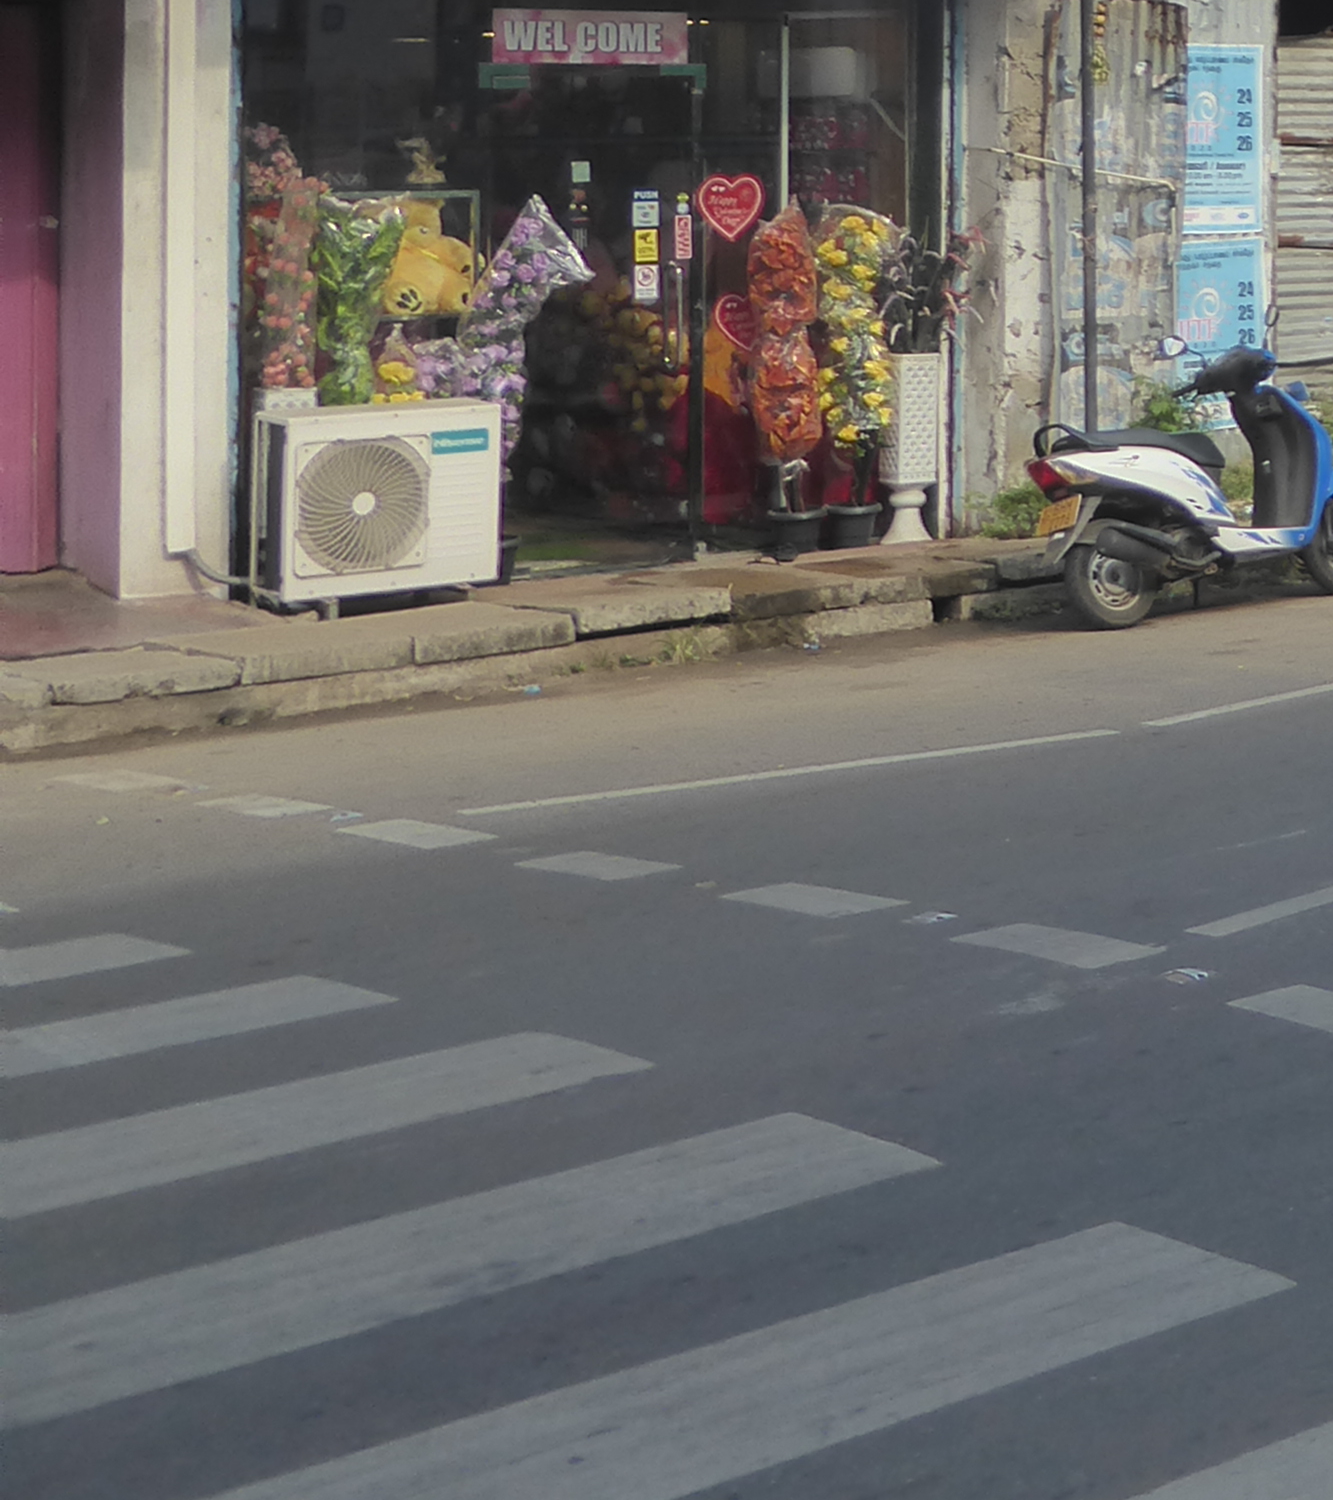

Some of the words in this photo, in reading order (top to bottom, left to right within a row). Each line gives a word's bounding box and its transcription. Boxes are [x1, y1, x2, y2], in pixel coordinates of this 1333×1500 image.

[503, 20, 570, 52] WEL
[576, 21, 663, 54] COME
[1237, 88, 1252, 104] 24
[1237, 112, 1252, 128] 25
[1237, 136, 1253, 152] 26
[1238, 281, 1254, 298] 24
[1238, 305, 1254, 321] 25
[1238, 329, 1255, 345] 26
